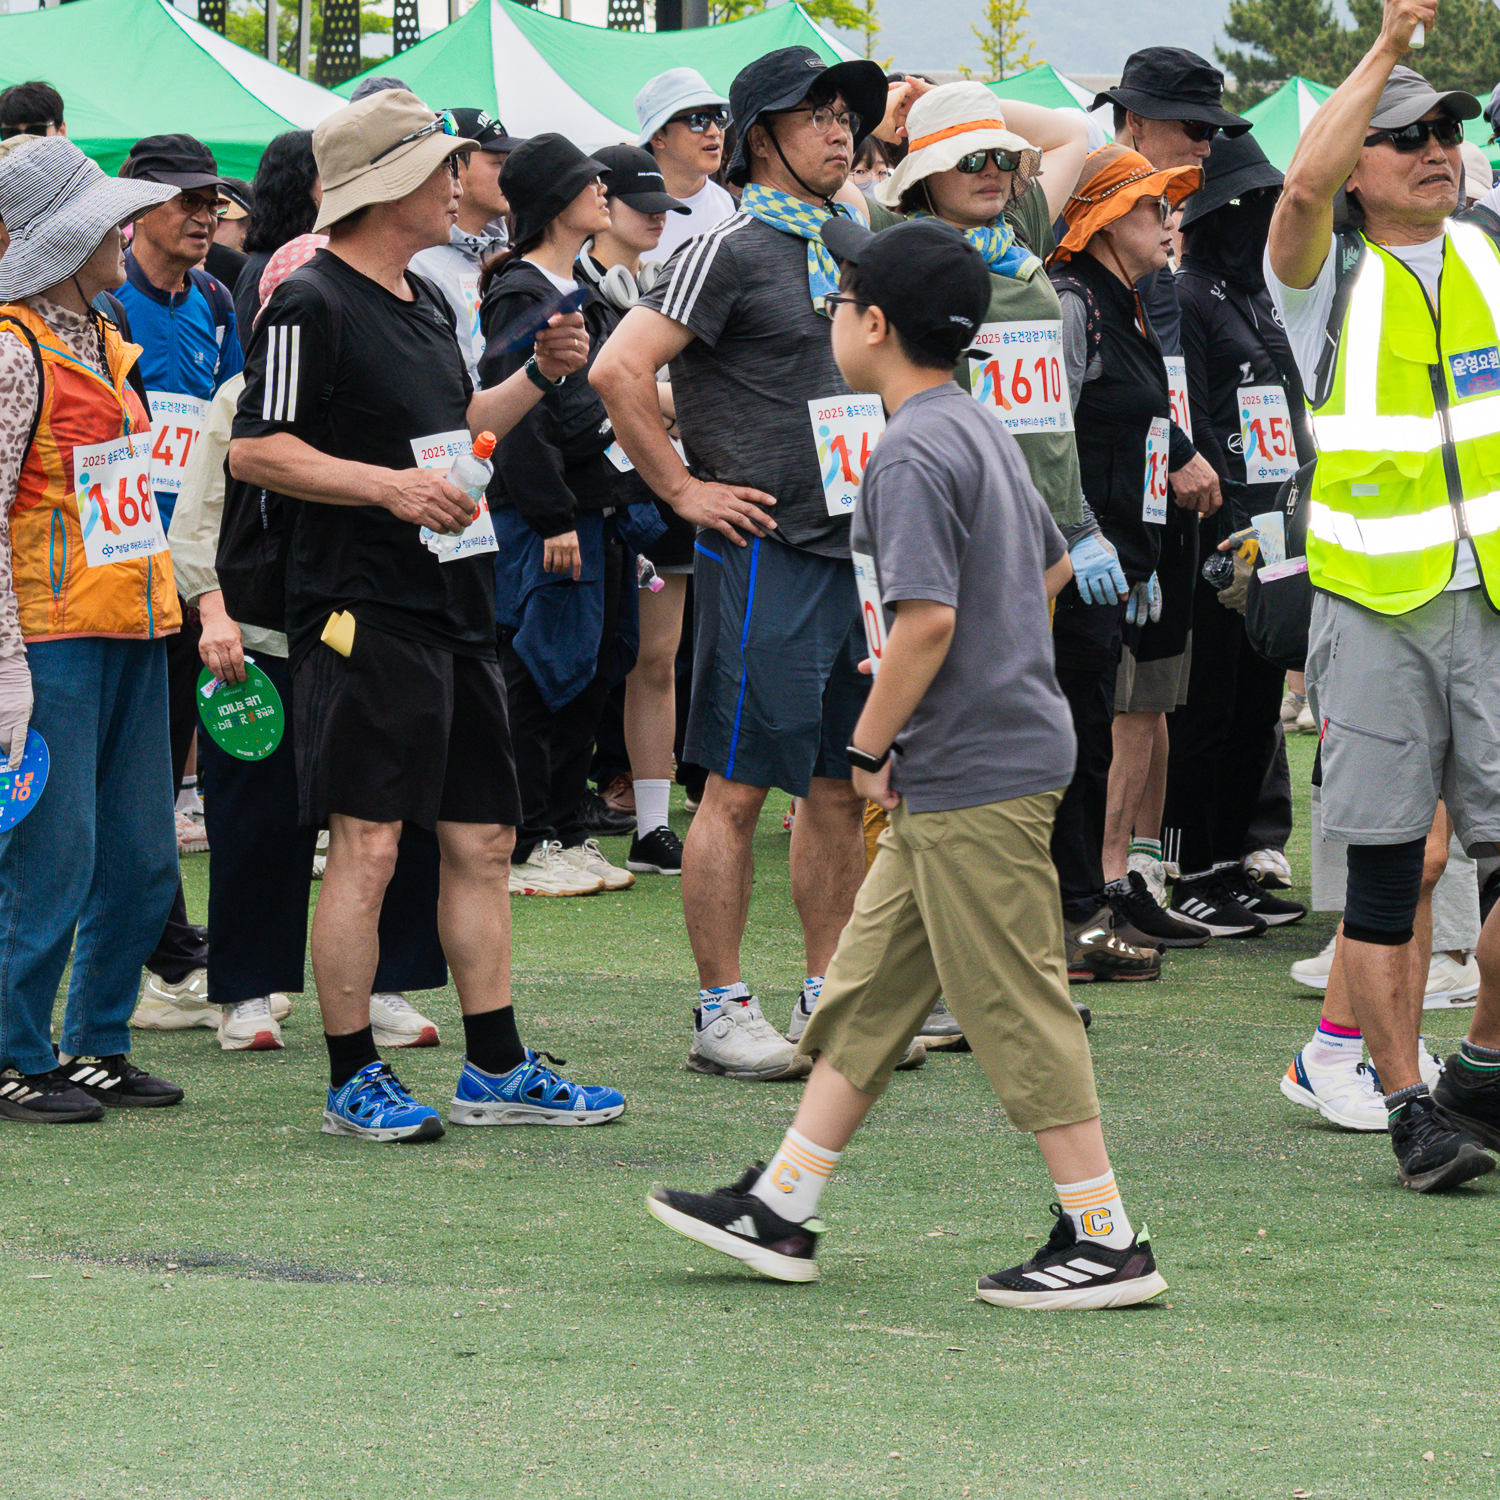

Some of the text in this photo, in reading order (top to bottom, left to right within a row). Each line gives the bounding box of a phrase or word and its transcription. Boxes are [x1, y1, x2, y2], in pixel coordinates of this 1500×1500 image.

[975, 334, 1000, 346] 2025
[1452, 350, 1500, 377] 운영요원
[984, 357, 1062, 406] 1610
[817, 407, 844, 421] 2025
[1241, 395, 1261, 406] 2025
[152, 425, 200, 468] 47
[421, 445, 446, 460] 2025
[82, 454, 106, 468] 2025
[88, 473, 152, 532] 168
[772, 1160, 800, 1194] C
[1080, 1207, 1114, 1238] C
